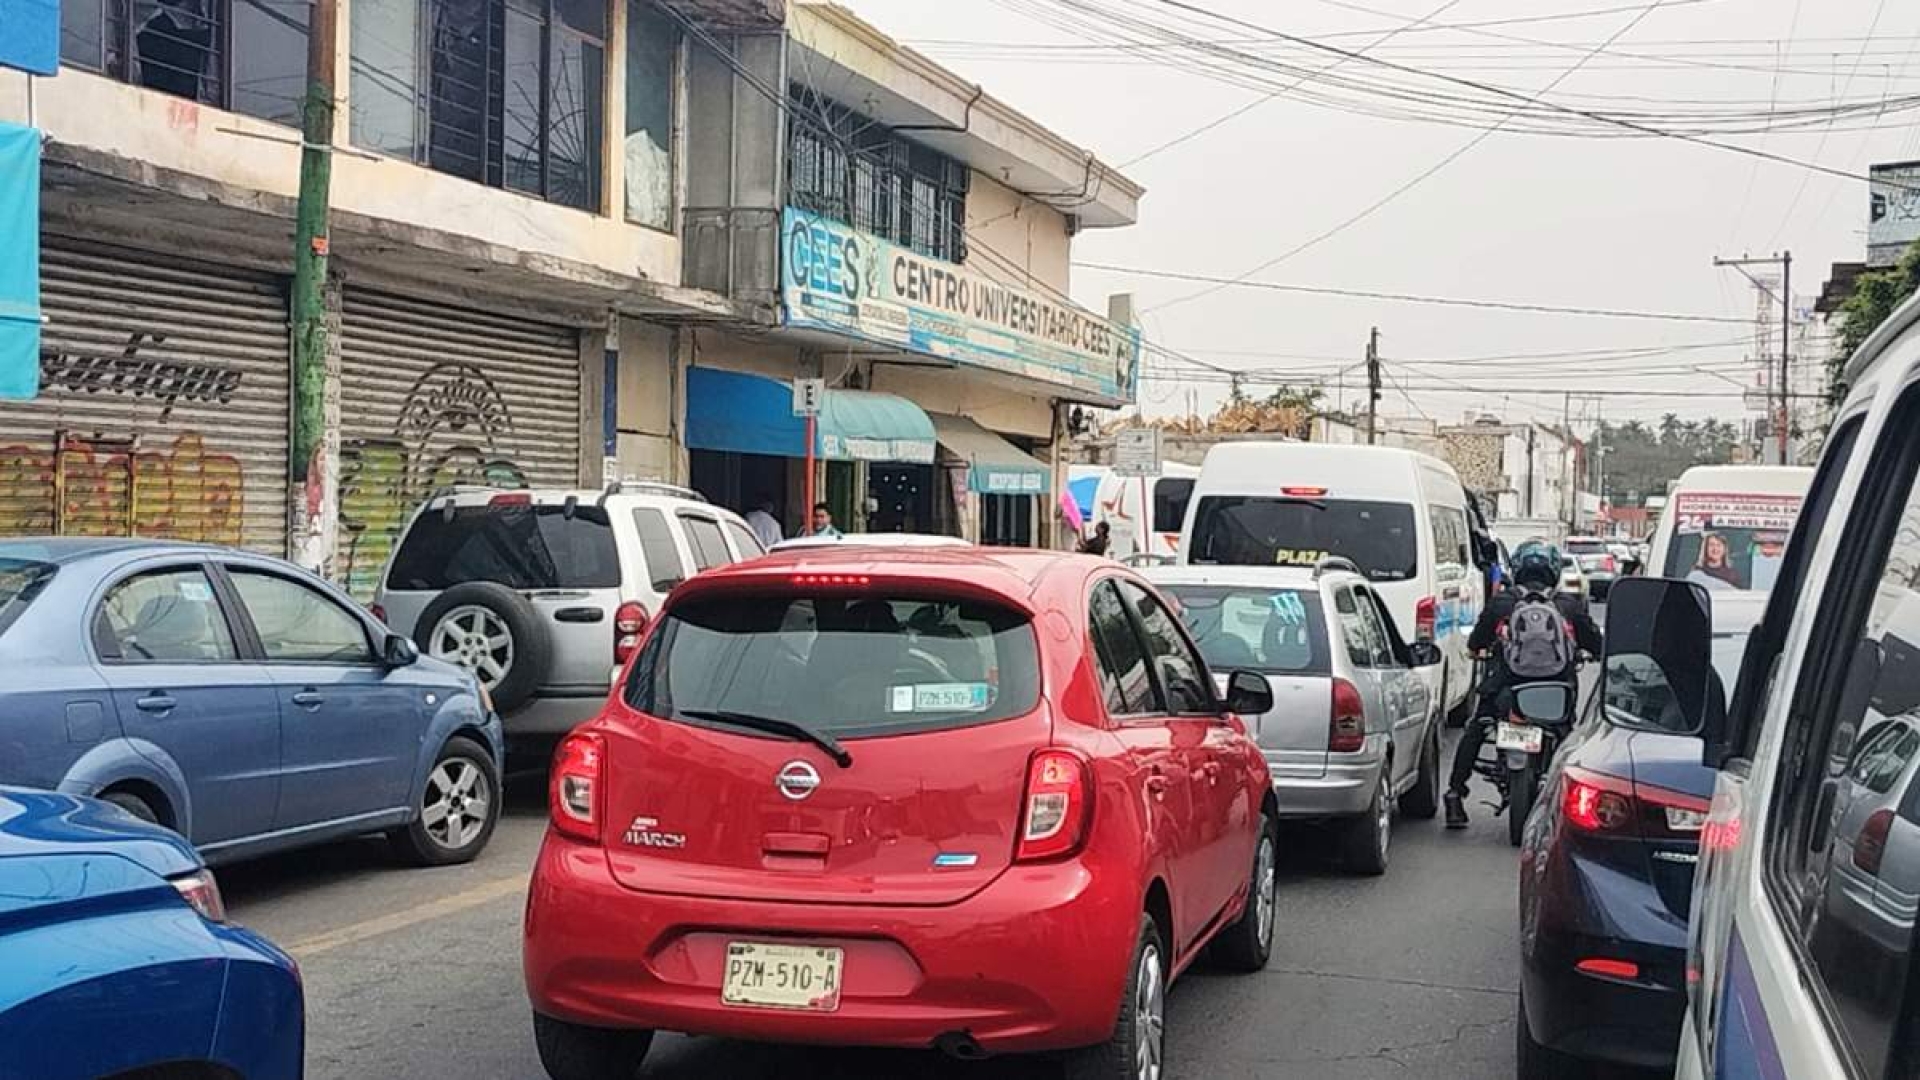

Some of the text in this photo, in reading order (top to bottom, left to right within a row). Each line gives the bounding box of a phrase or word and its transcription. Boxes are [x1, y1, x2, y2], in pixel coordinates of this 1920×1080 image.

[789, 220, 860, 300] CEES
[893, 255, 970, 314] CENTRO
[973, 281, 1080, 347] UNIVERSITARIO
[1081, 317, 1112, 356] CEES
[1276, 549, 1330, 564] PLAZA
[622, 831, 686, 849] MARCH
[728, 958, 836, 991] PZM-510-A
